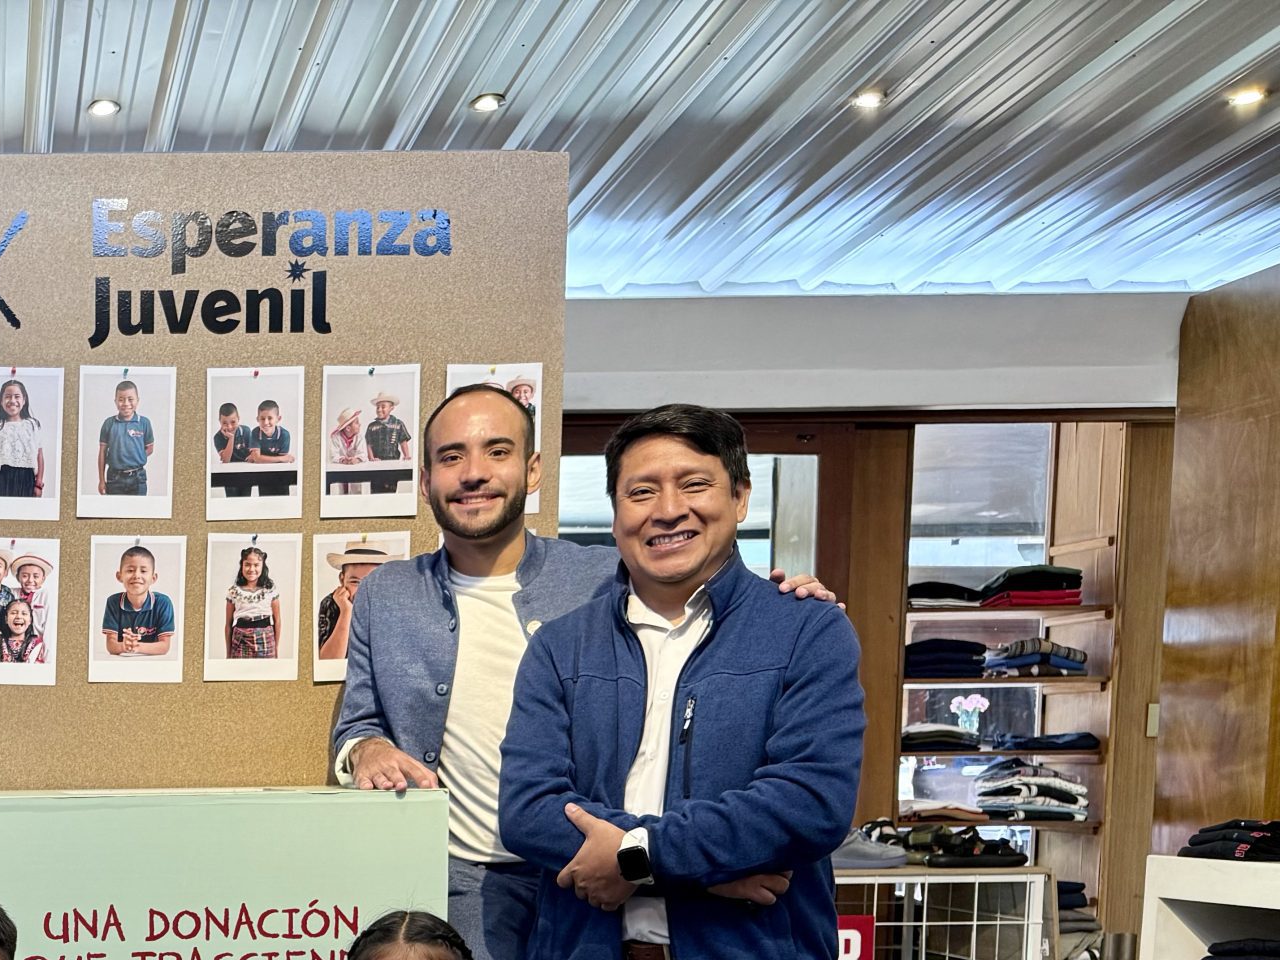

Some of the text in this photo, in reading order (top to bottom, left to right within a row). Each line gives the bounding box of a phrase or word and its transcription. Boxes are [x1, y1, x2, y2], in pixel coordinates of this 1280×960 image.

[91, 197, 452, 275] Esperanza
[88, 259, 332, 349] Juvenil
[43, 899, 360, 943] UNA DONACIÓN
